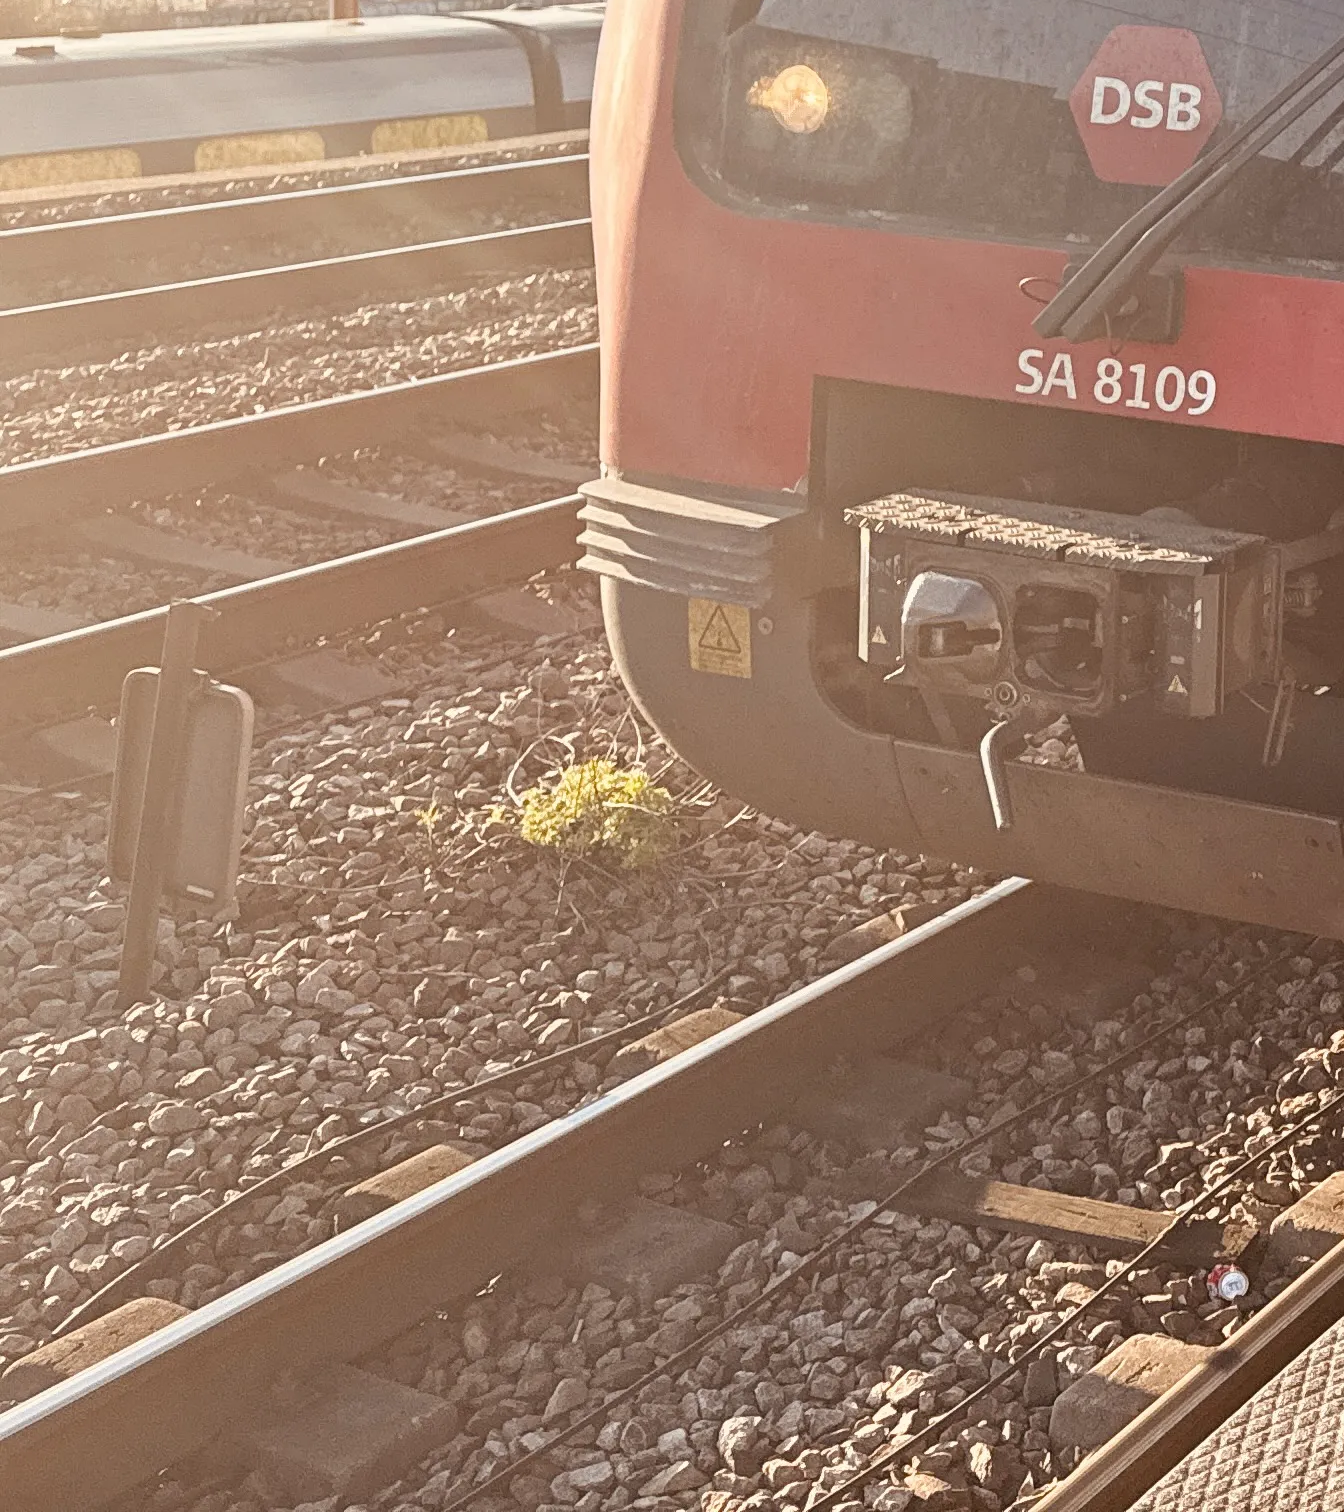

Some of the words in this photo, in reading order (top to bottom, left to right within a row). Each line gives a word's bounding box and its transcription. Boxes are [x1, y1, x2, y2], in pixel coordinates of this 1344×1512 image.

[1089, 75, 1202, 133] DSB
[1014, 347, 1077, 400] SA
[1092, 356, 1217, 416] 8109
